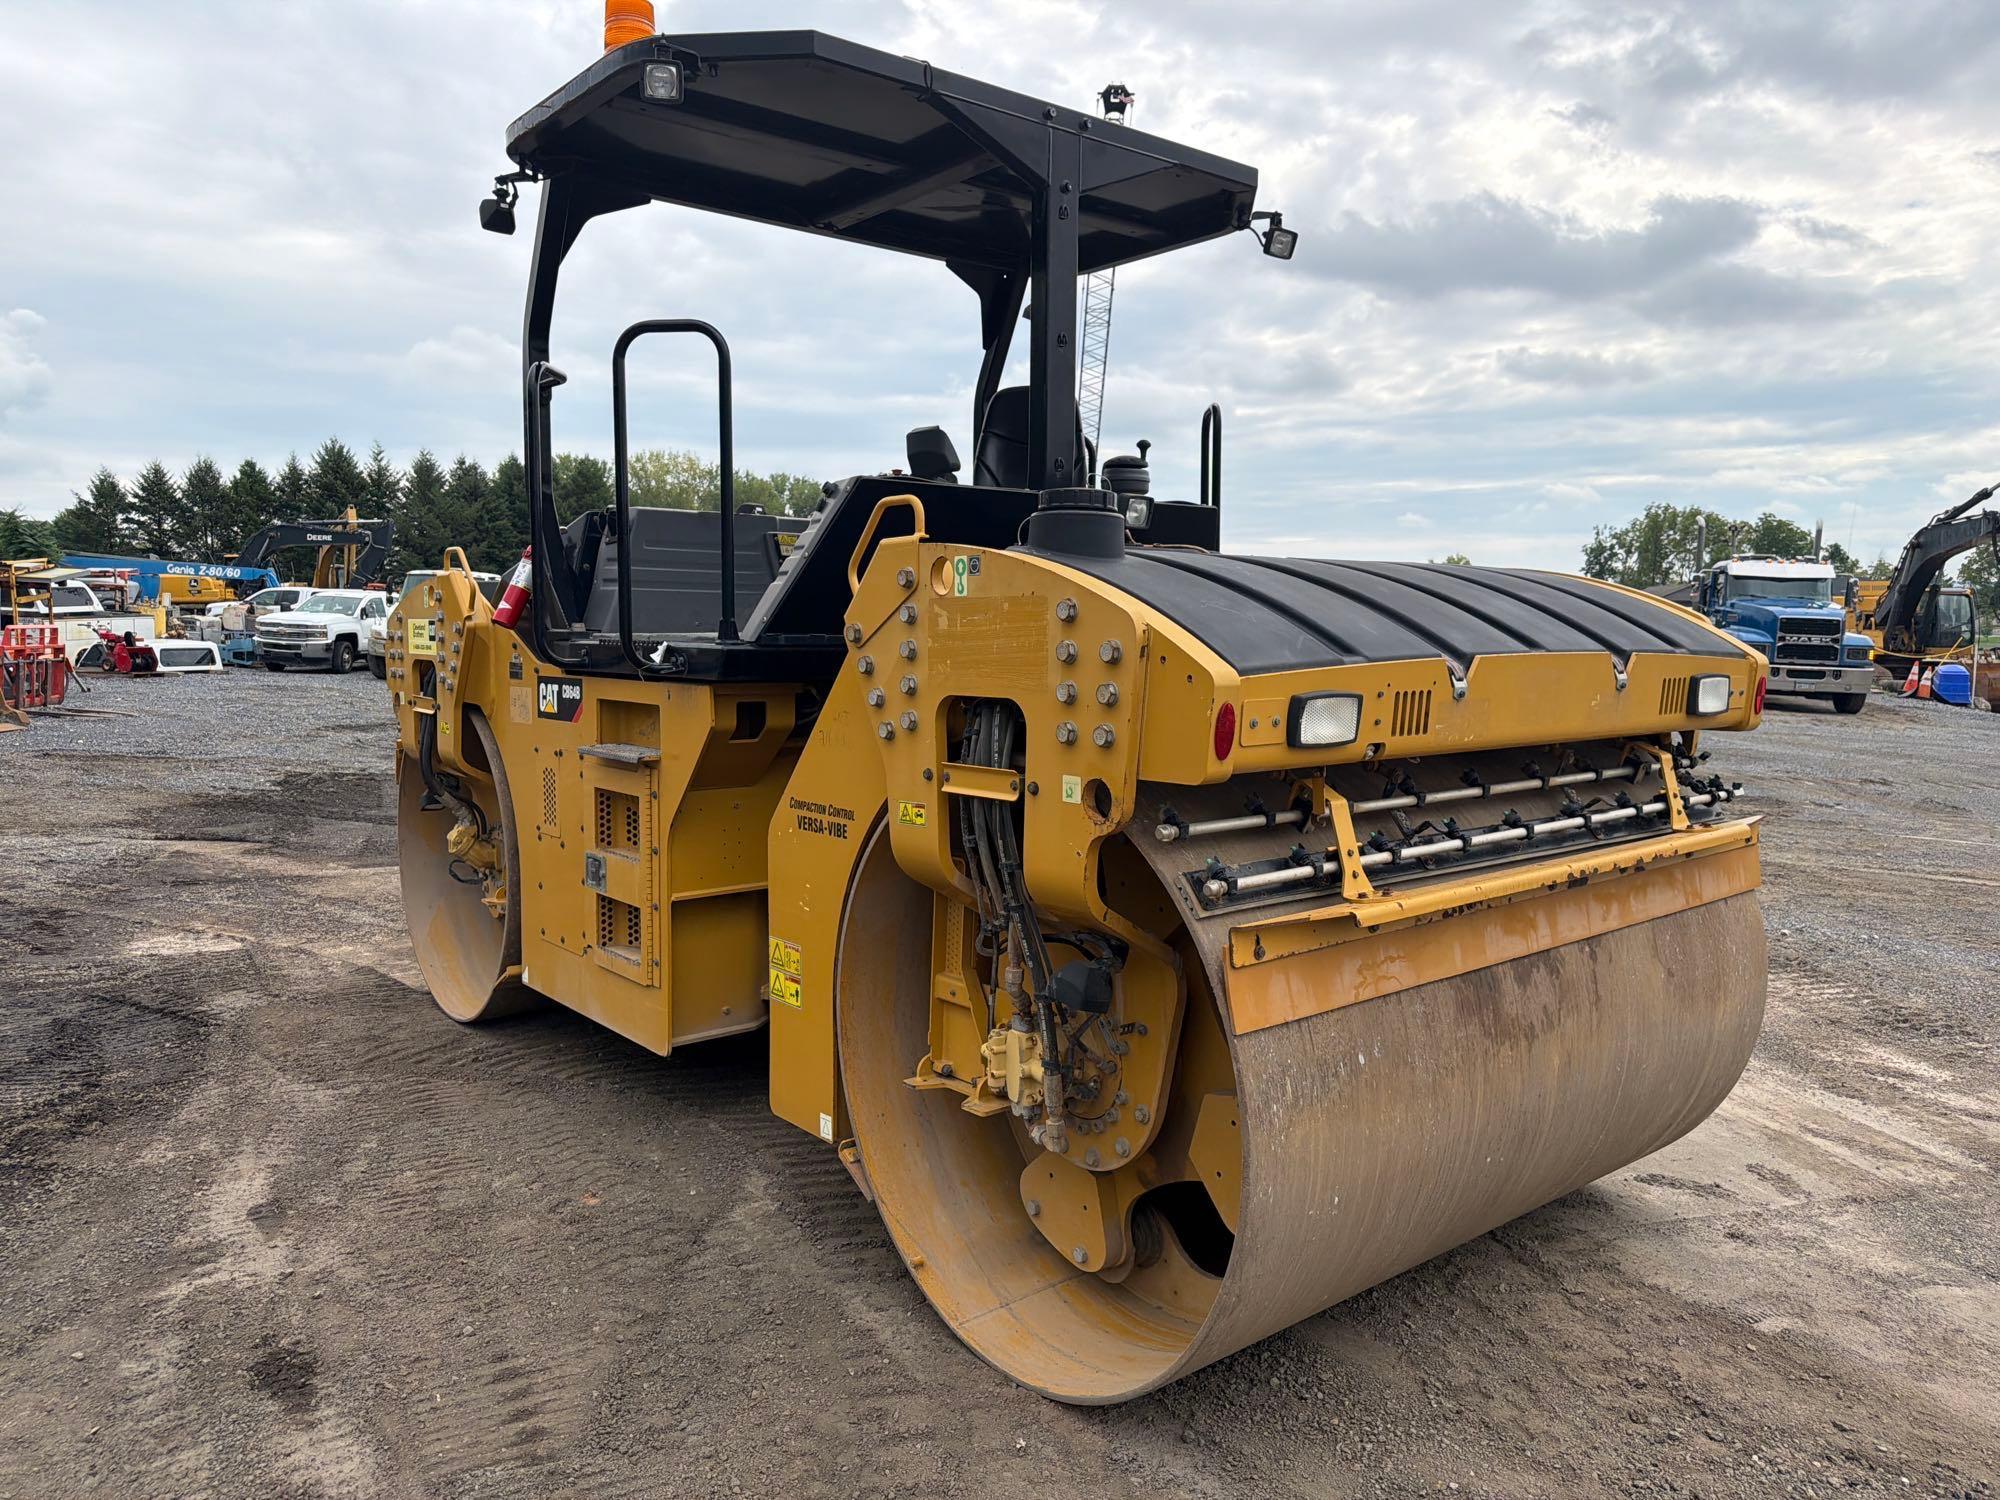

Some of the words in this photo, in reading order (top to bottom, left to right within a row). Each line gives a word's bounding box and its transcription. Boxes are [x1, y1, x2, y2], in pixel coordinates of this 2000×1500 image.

[306, 533, 333, 541] DEERE
[166, 563, 196, 575] Genie
[198, 565, 241, 578] Z-80/60
[540, 683, 558, 713] CAT
[797, 815, 848, 839] VERSA-VIBE
